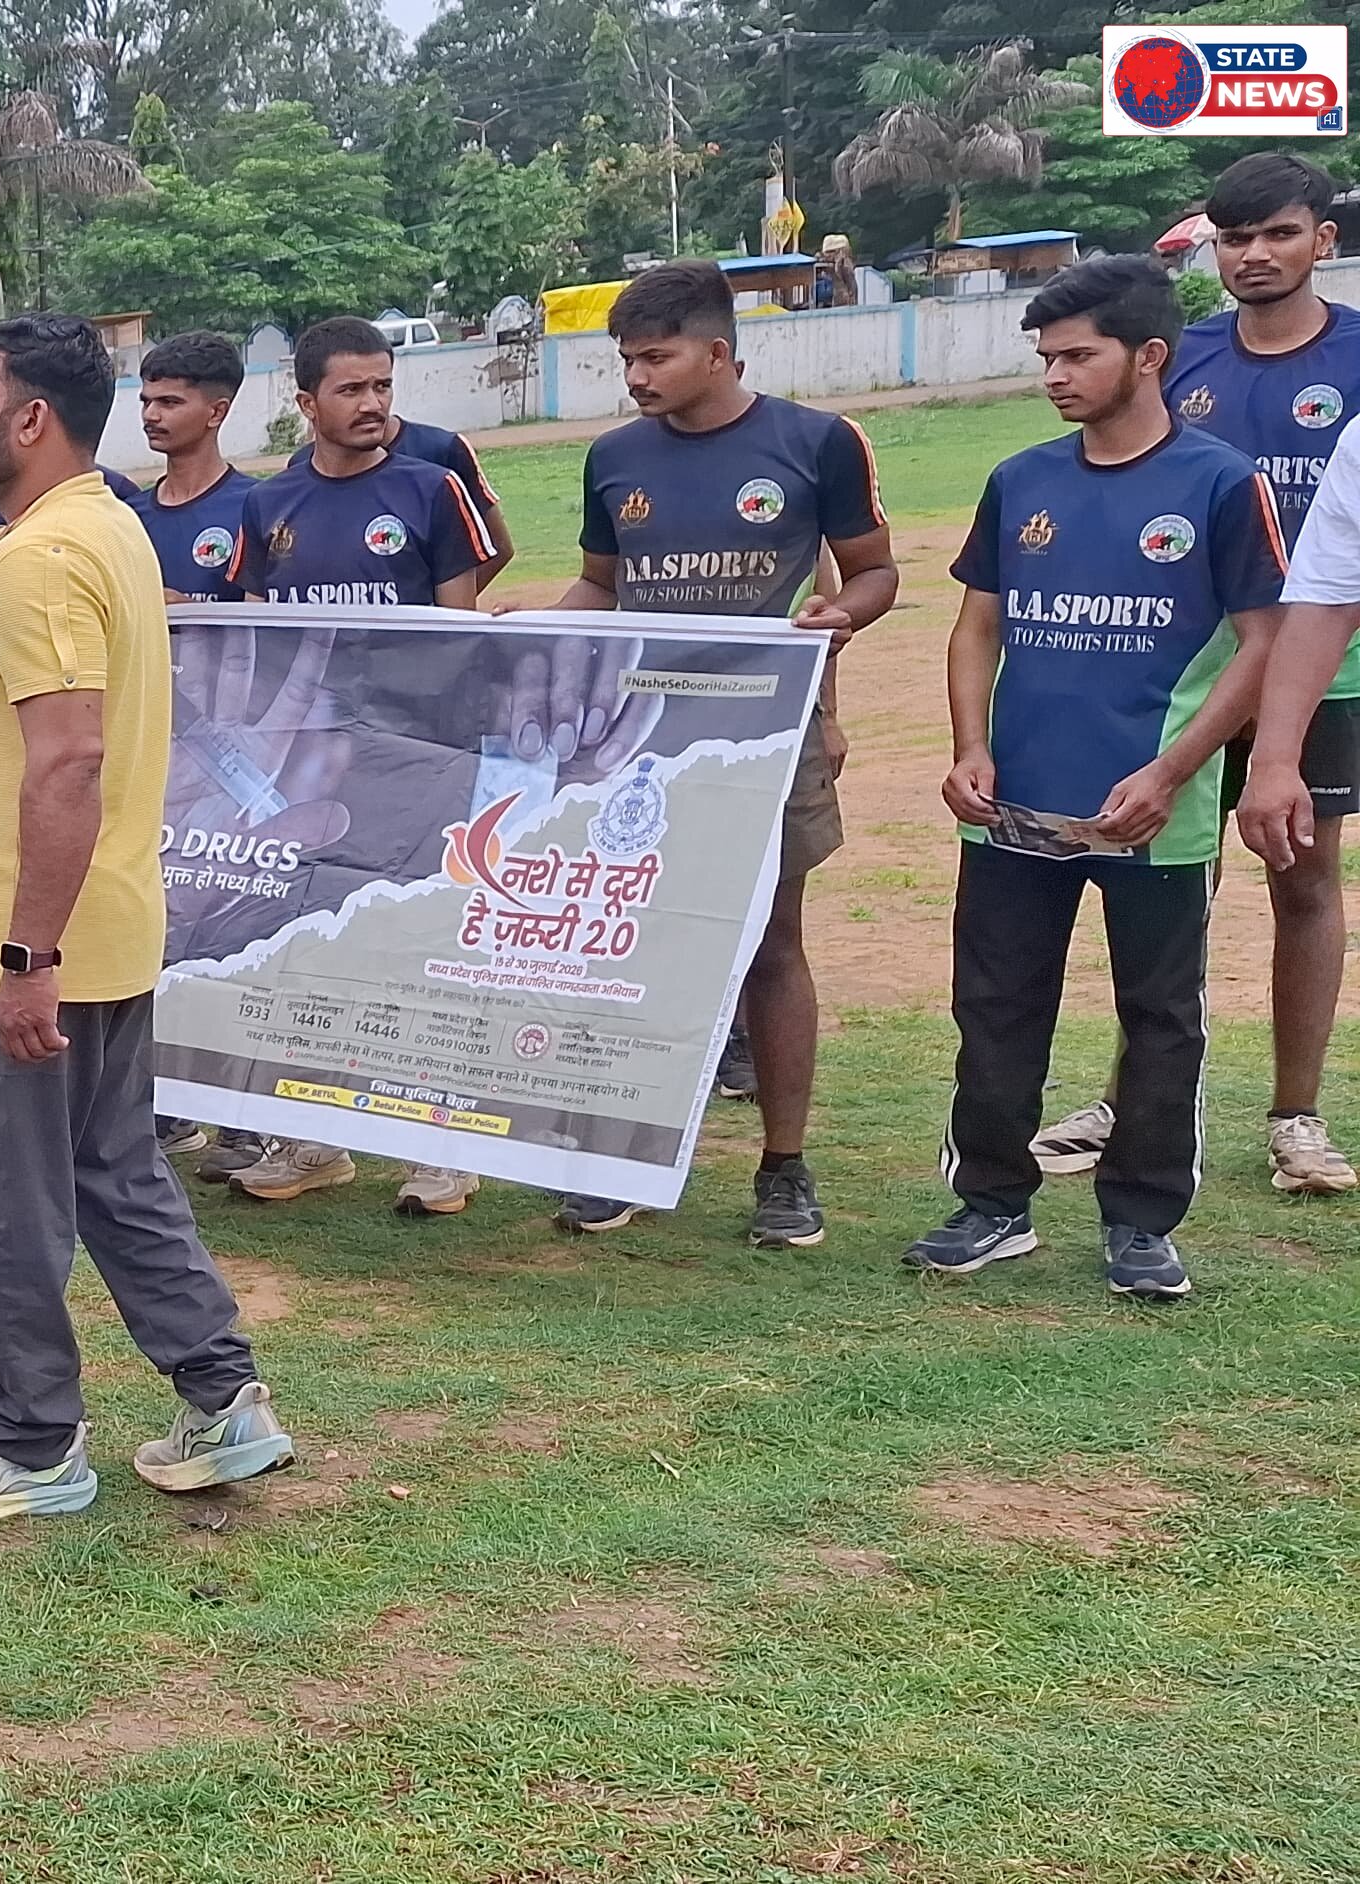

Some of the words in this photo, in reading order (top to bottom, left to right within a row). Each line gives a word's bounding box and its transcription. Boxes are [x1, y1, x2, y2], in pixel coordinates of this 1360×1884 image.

[1105, 633, 1156, 652] ITEMS
[624, 676, 771, 694] #NasheSeDooriHaiZaroori
[180, 827, 302, 873] DRUGS
[215, 872, 250, 893] मध्य
[251, 873, 292, 899] प्रदेश
[502, 848, 563, 895] नशे
[564, 851, 601, 898] से
[602, 853, 659, 917] दूरी
[461, 891, 490, 946] है
[494, 903, 582, 952] ज़रूरी
[580, 919, 635, 956] 2.0
[237, 1003, 271, 1021] 1933
[291, 1012, 332, 1029] 14416
[354, 1020, 401, 1040] 14446
[369, 1079, 405, 1097] जिला
[405, 1087, 444, 1105] पुलिस
